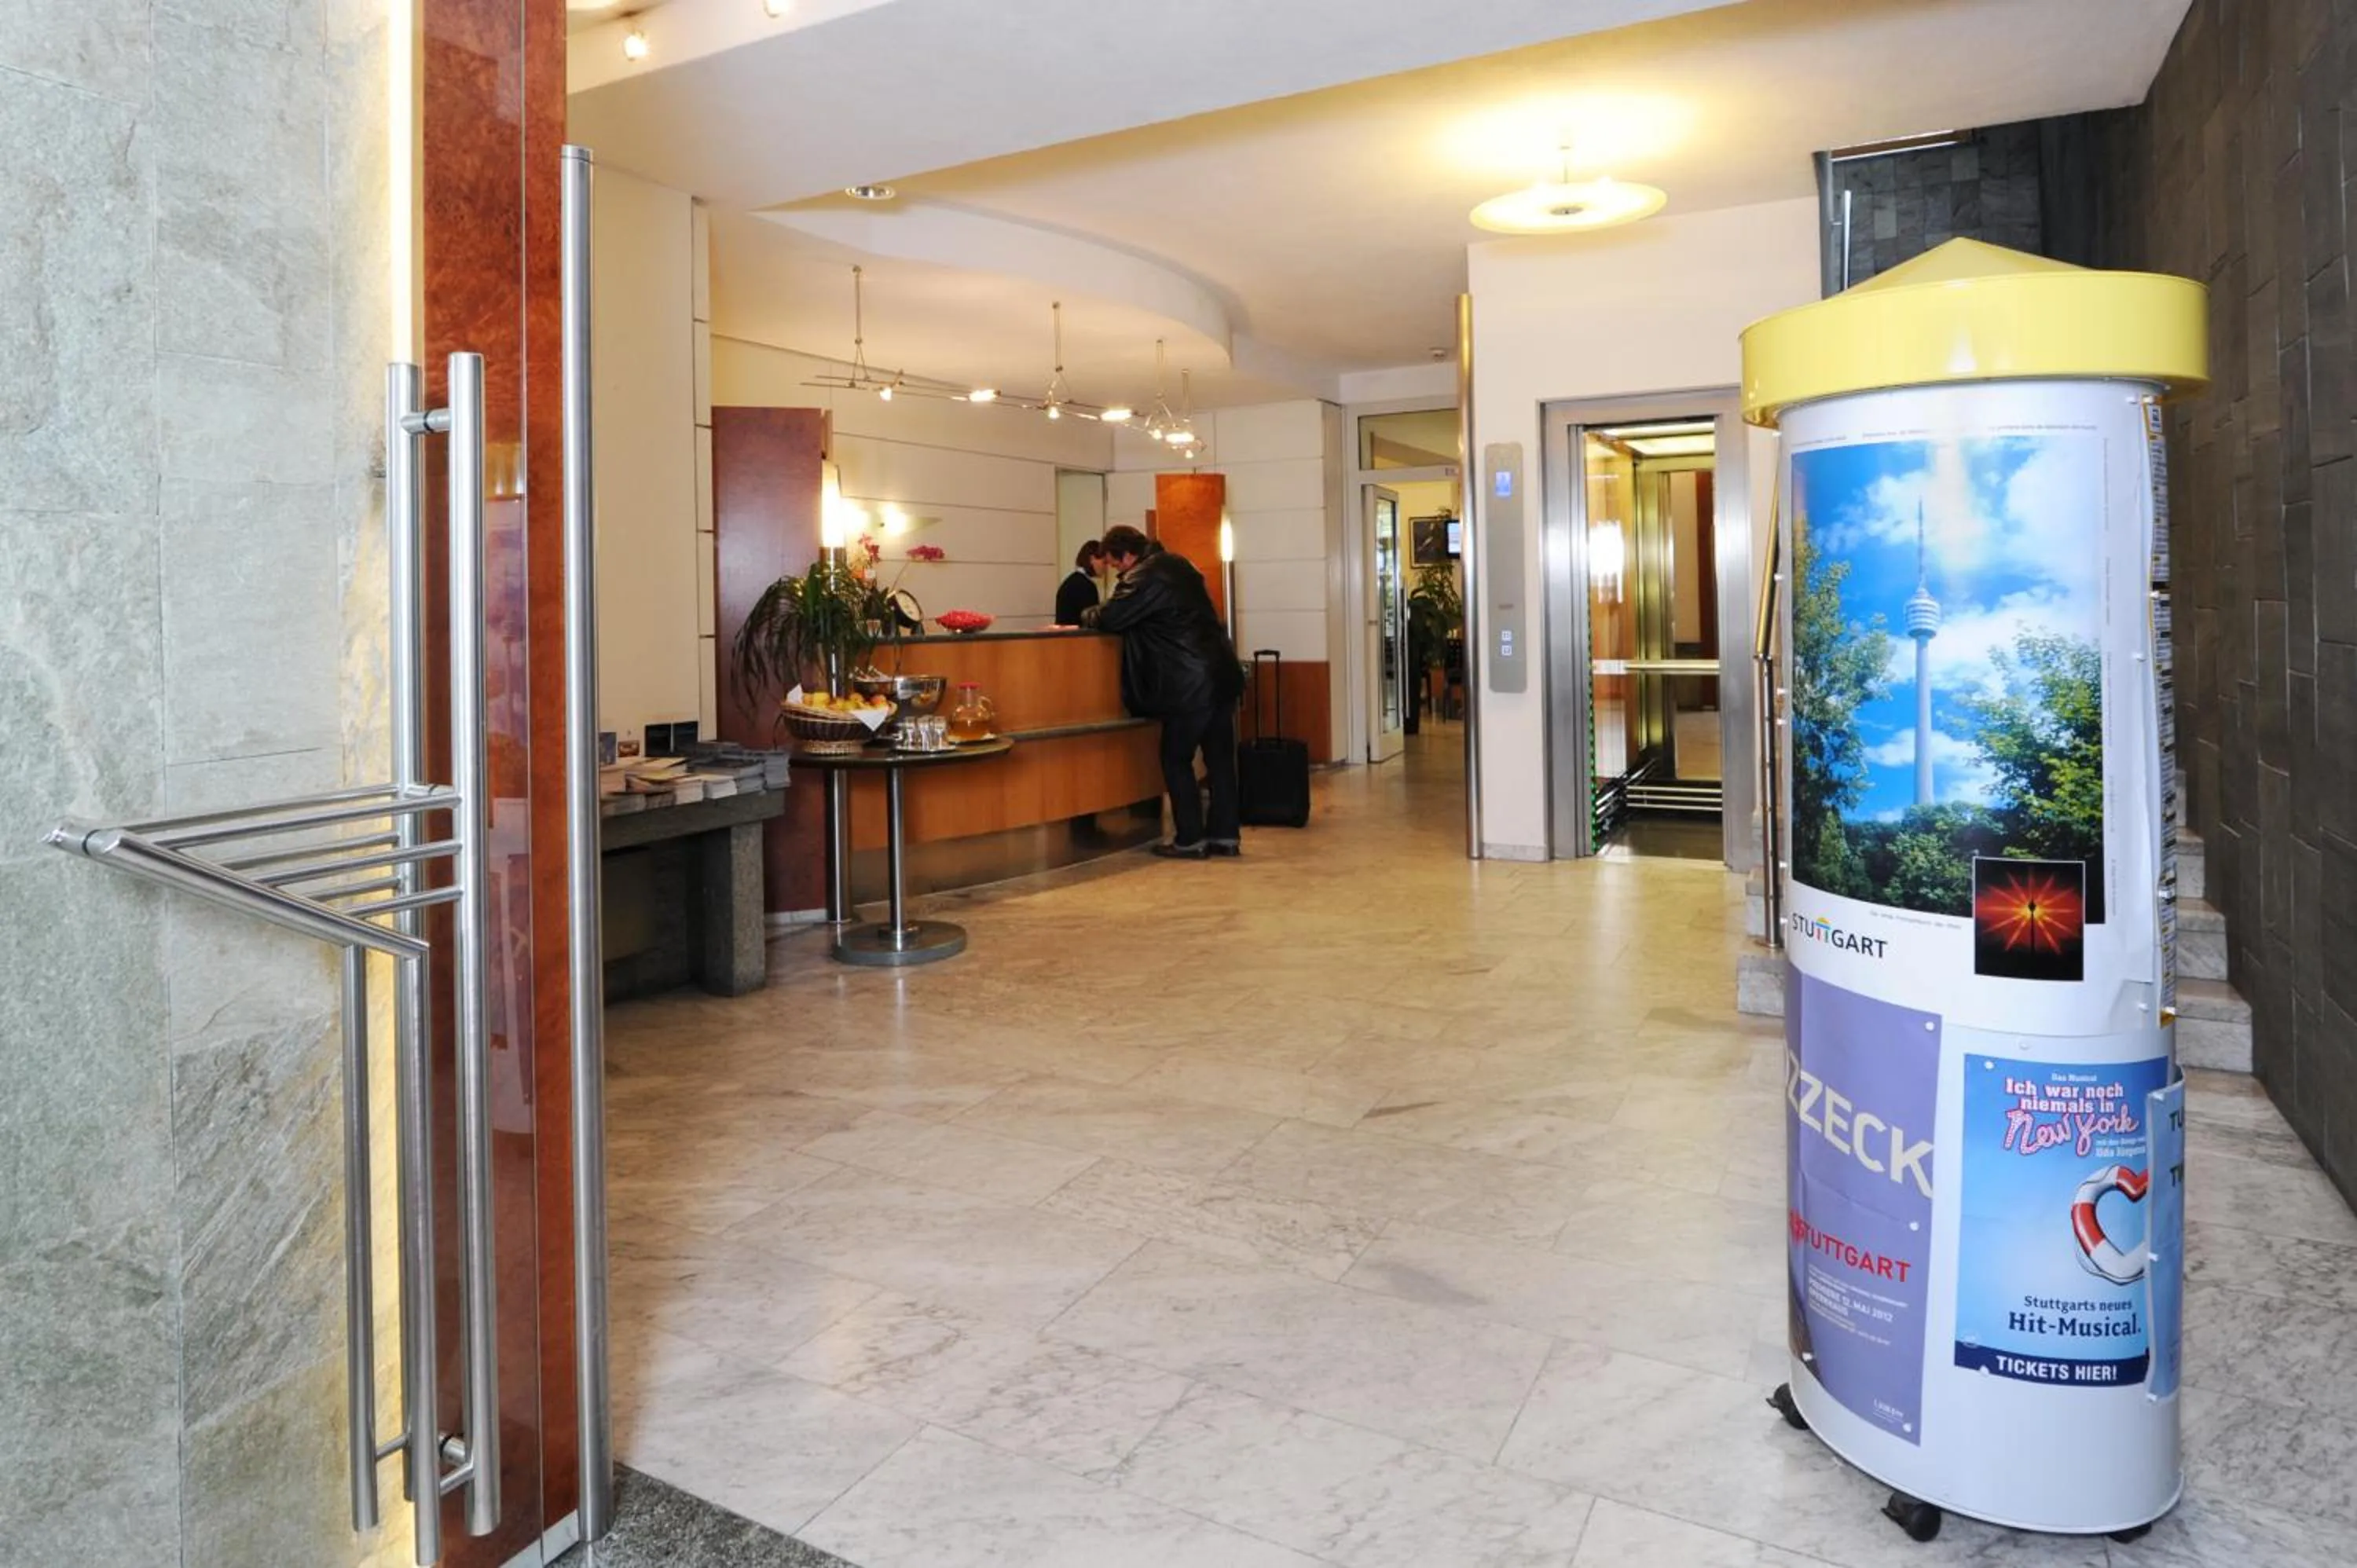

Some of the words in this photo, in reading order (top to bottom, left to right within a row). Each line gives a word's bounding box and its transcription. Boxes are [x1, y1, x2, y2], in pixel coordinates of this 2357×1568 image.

[1792, 913, 1888, 958] STUTTGART
[2005, 1076, 2037, 1097] Ich
[2045, 1084, 2080, 1098] war
[2085, 1081, 2124, 1099] noch
[2019, 1096, 2095, 1114] niemals
[2099, 1097, 2115, 1114] in
[2004, 1108, 2072, 1156] New
[2074, 1102, 2140, 1157] York
[2024, 1295, 2096, 1313] Stuttgarts
[2099, 1300, 2132, 1311] neues
[2008, 1311, 2142, 1337] Hit-Musical.
[1996, 1355, 2069, 1380] TICKETS
[2074, 1365, 2117, 1380] HIER!
